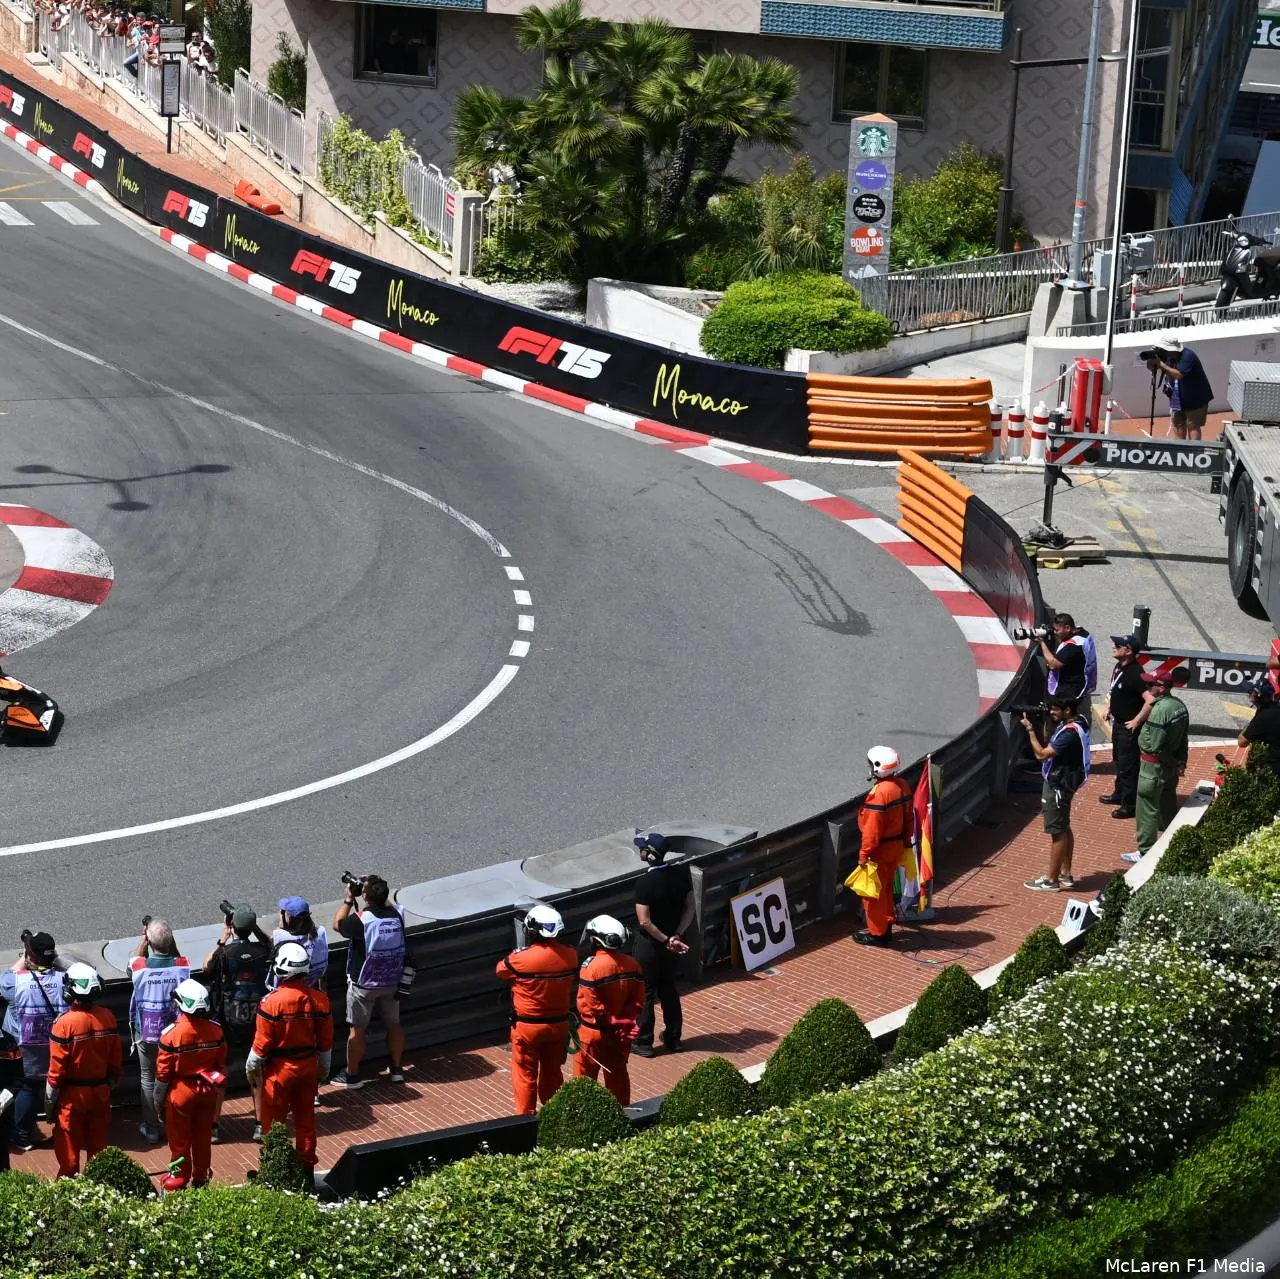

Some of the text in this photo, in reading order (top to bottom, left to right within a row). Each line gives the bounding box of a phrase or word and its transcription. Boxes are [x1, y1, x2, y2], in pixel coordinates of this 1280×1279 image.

[224, 213, 260, 258] Monaco
[851, 237, 884, 248] BOWLING
[387, 279, 439, 328] Monaco
[557, 341, 612, 379] 75
[652, 363, 749, 419] Monaco
[1106, 448, 1213, 468] PIOVANO
[742, 894, 786, 954] SC
